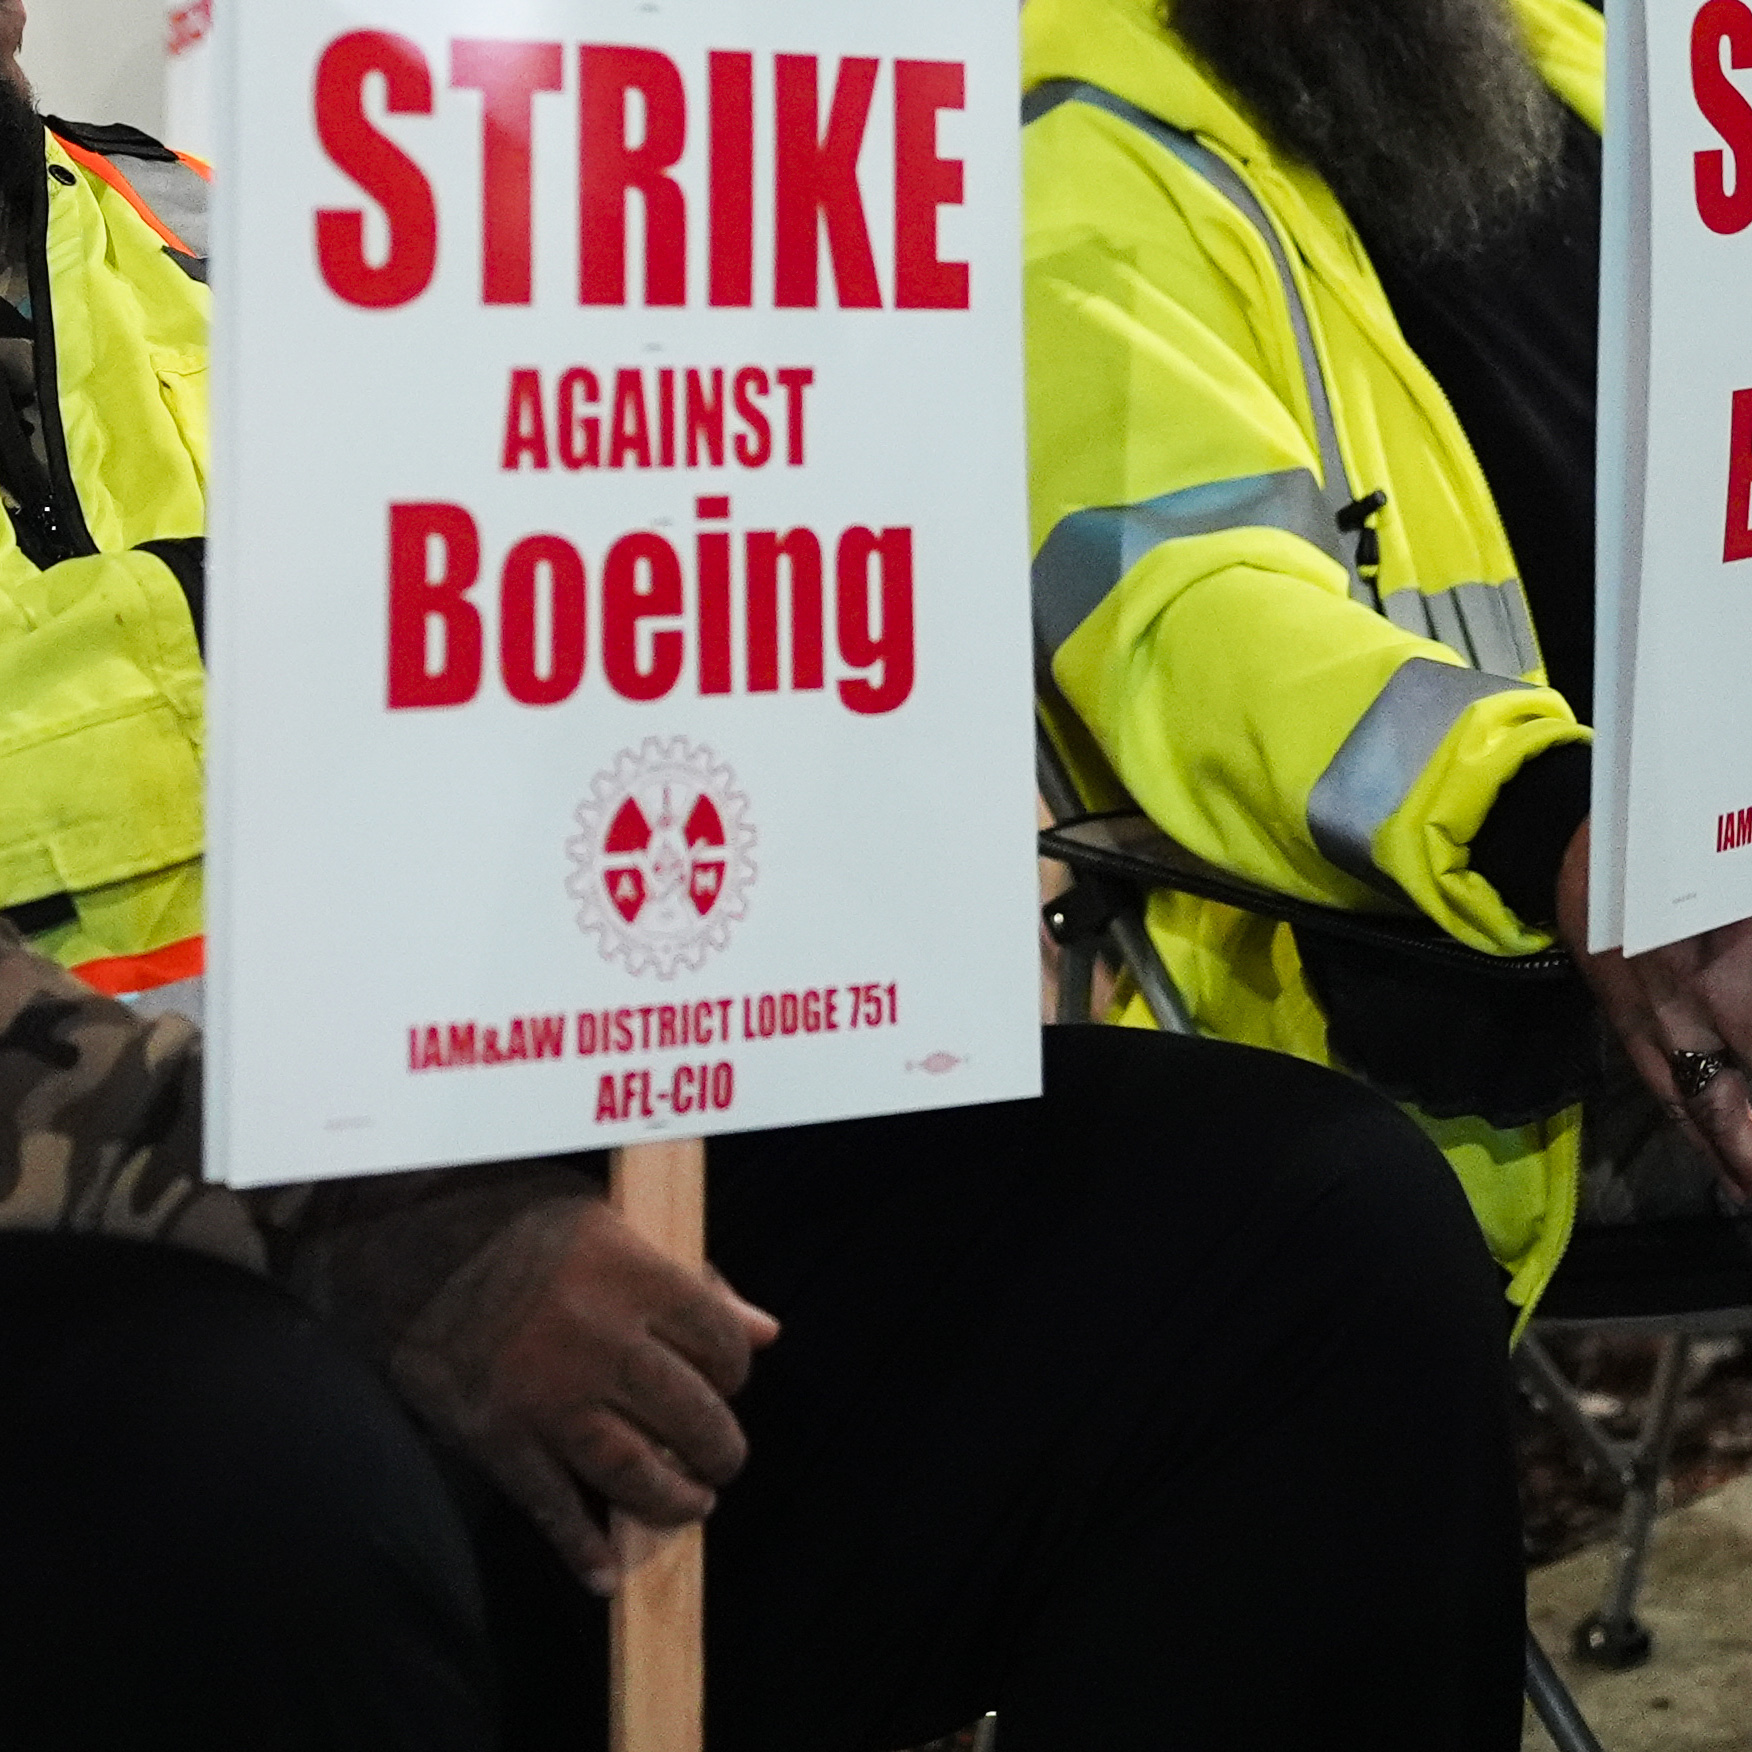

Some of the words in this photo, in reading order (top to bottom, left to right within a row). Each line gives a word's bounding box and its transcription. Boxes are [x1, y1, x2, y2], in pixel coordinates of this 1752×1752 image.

[310, 26, 972, 312] STRIKE
[498, 363, 816, 473] AGAINST
[384, 493, 917, 716] Boeing
[408, 1015, 566, 1073] IAM&AW
[575, 998, 736, 1058] DISTRICT
[744, 987, 840, 1041] LODGE
[847, 981, 900, 1028] 751
[594, 1059, 736, 1125] AFL-CIO
